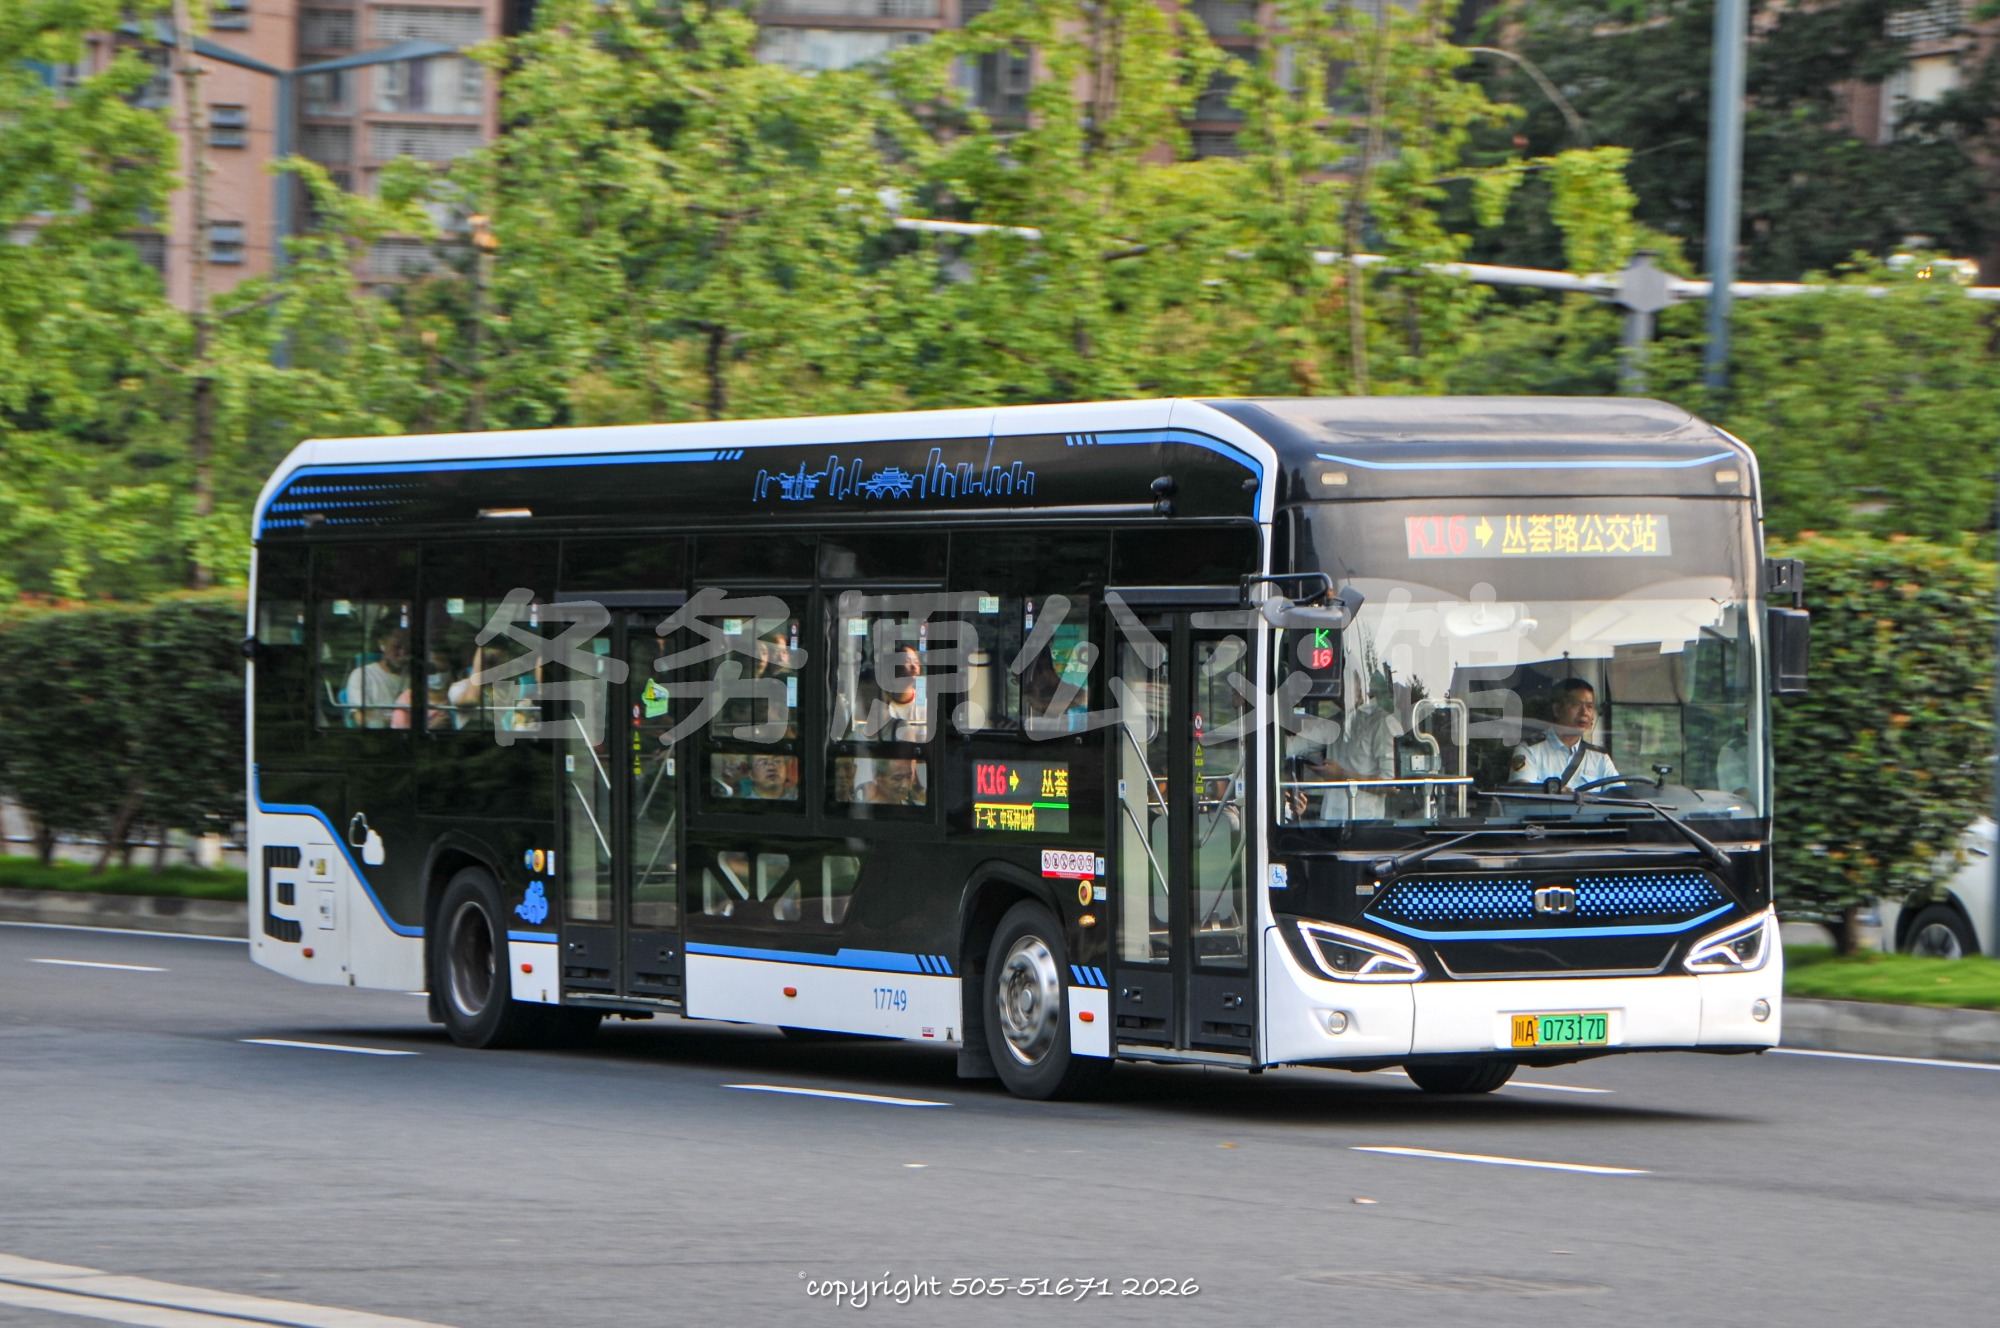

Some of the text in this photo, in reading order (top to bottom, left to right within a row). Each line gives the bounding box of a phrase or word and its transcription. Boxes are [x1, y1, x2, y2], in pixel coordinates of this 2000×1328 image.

[1408, 513, 1658, 555] K16 丛荟路公交站
[1315, 627, 1330, 648] K
[1312, 648, 1333, 669] 16
[977, 764, 1068, 797] K16 丛荟
[874, 988, 907, 1012] 17749
